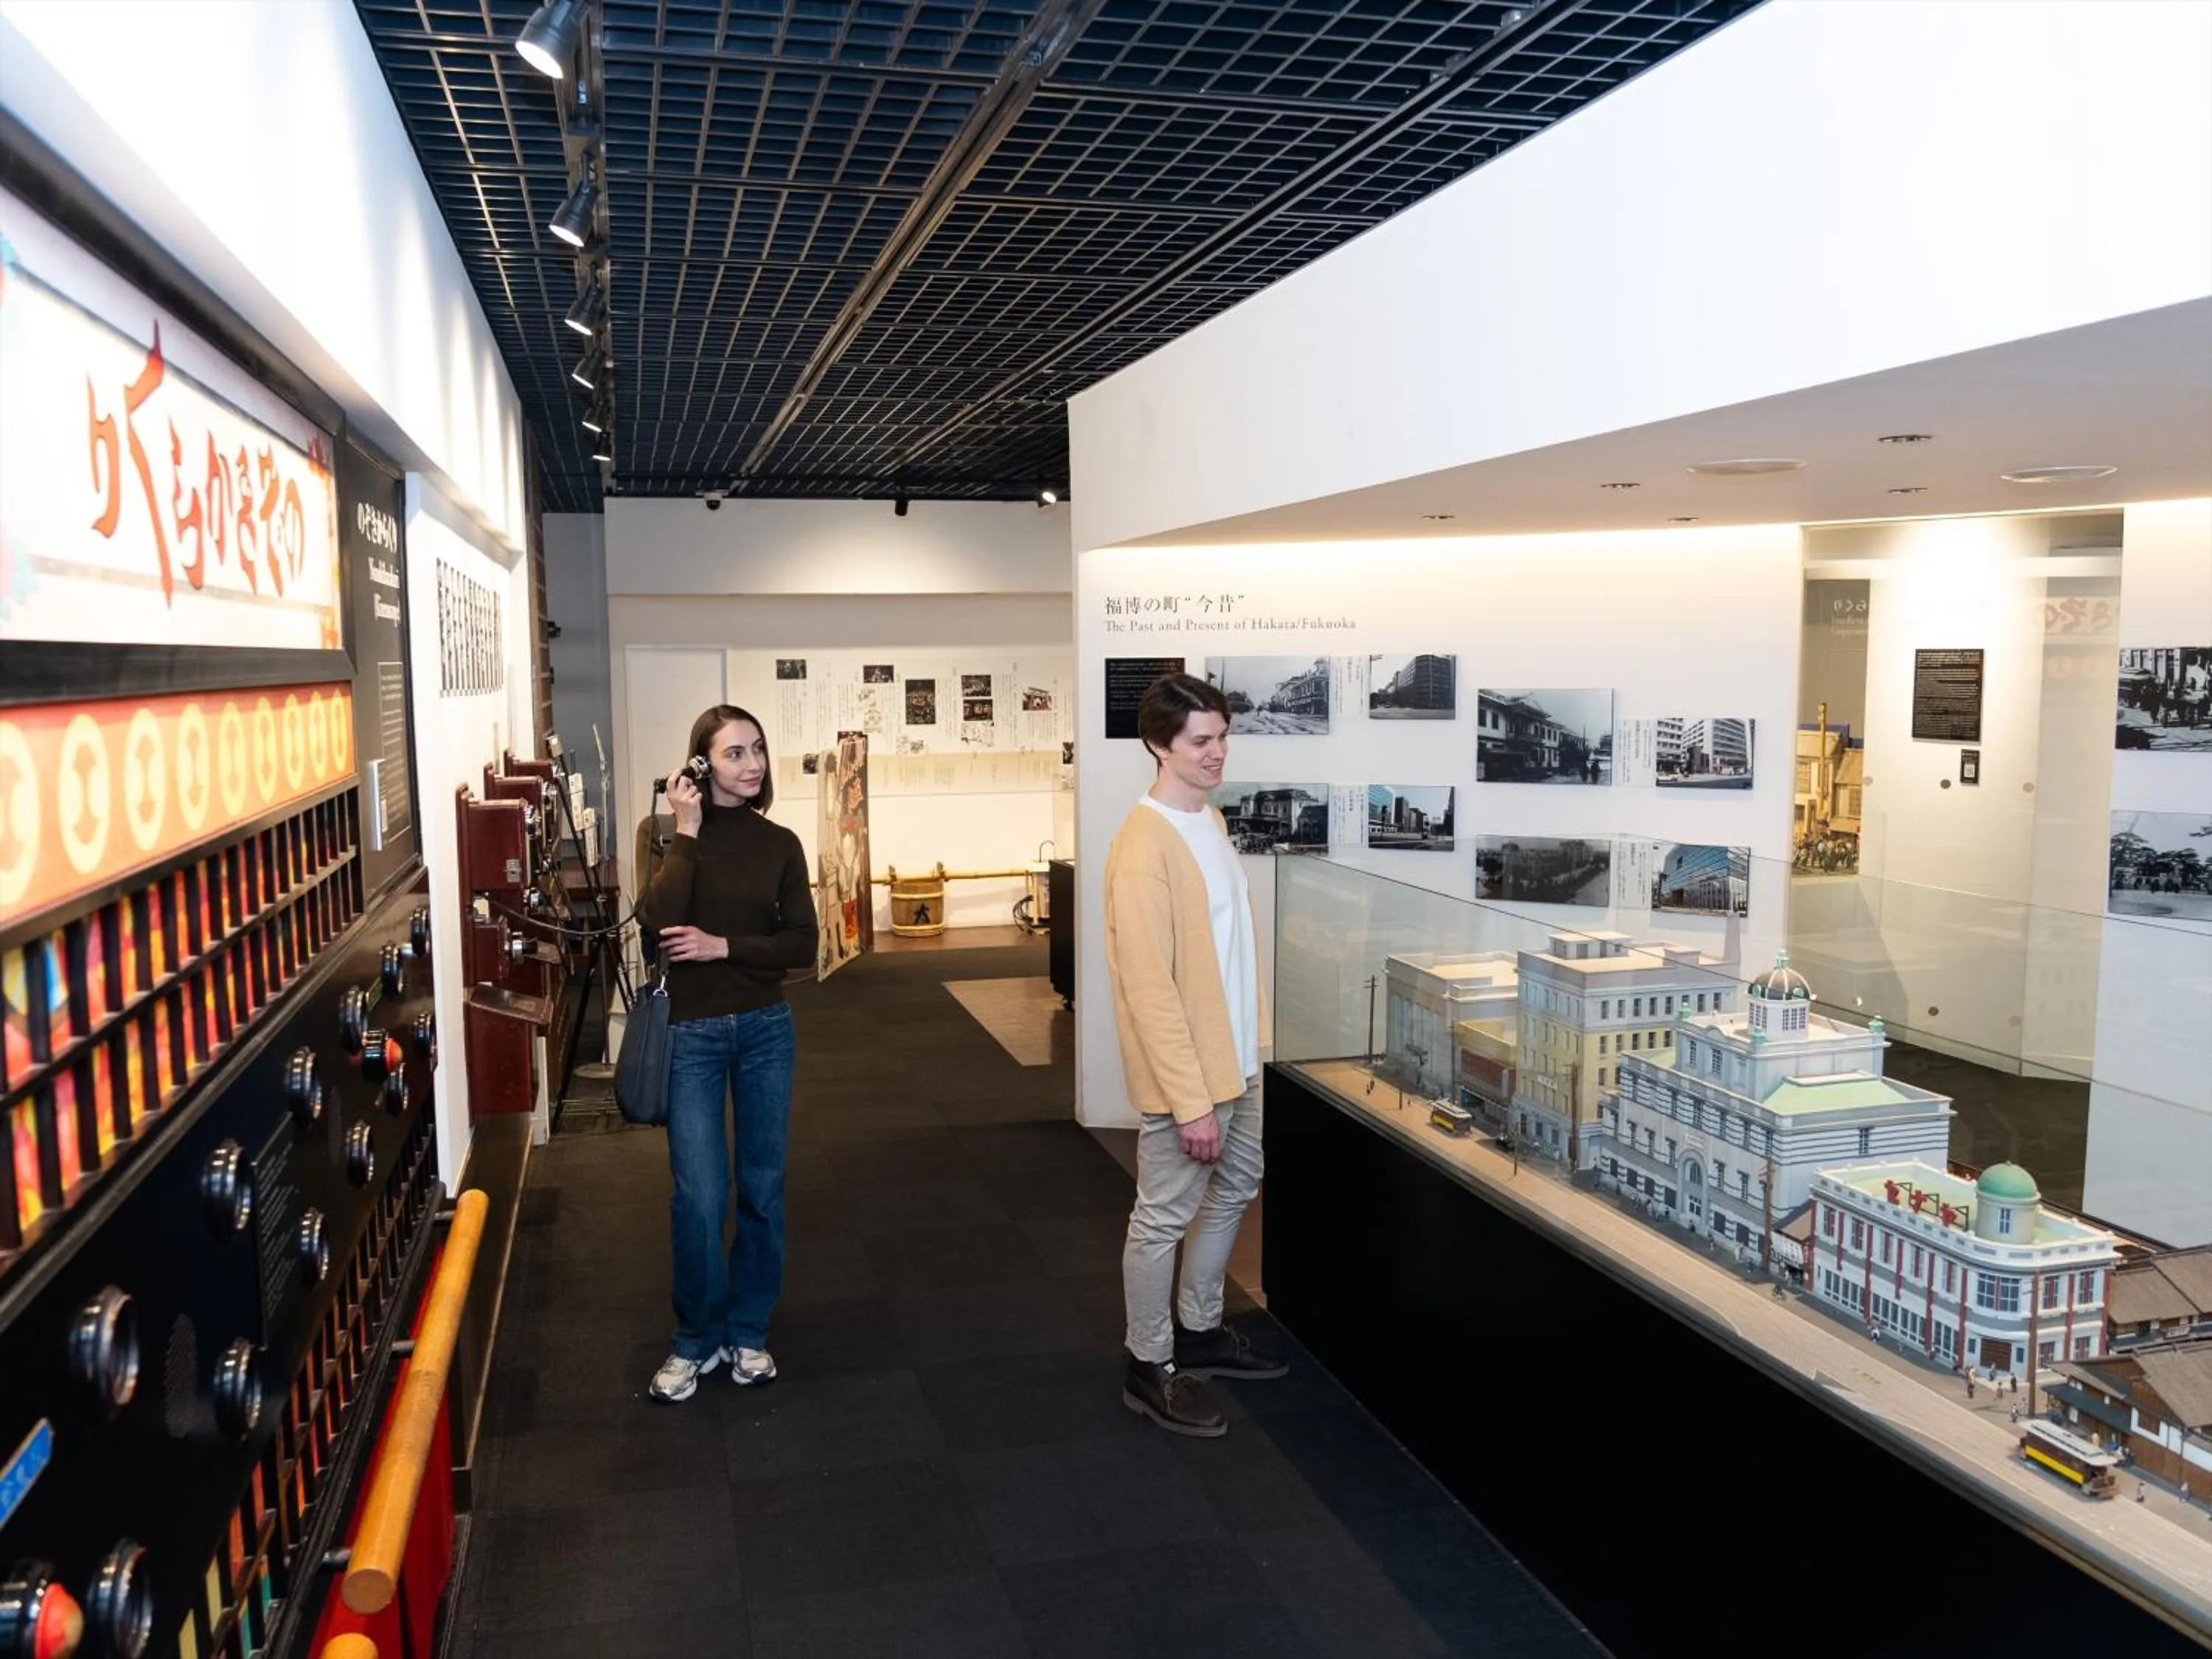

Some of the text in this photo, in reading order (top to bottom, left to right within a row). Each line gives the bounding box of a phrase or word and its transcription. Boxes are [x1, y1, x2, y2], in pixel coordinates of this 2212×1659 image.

[1106, 617, 1357, 632] The Past and Present of Hakata/Fukuoka
